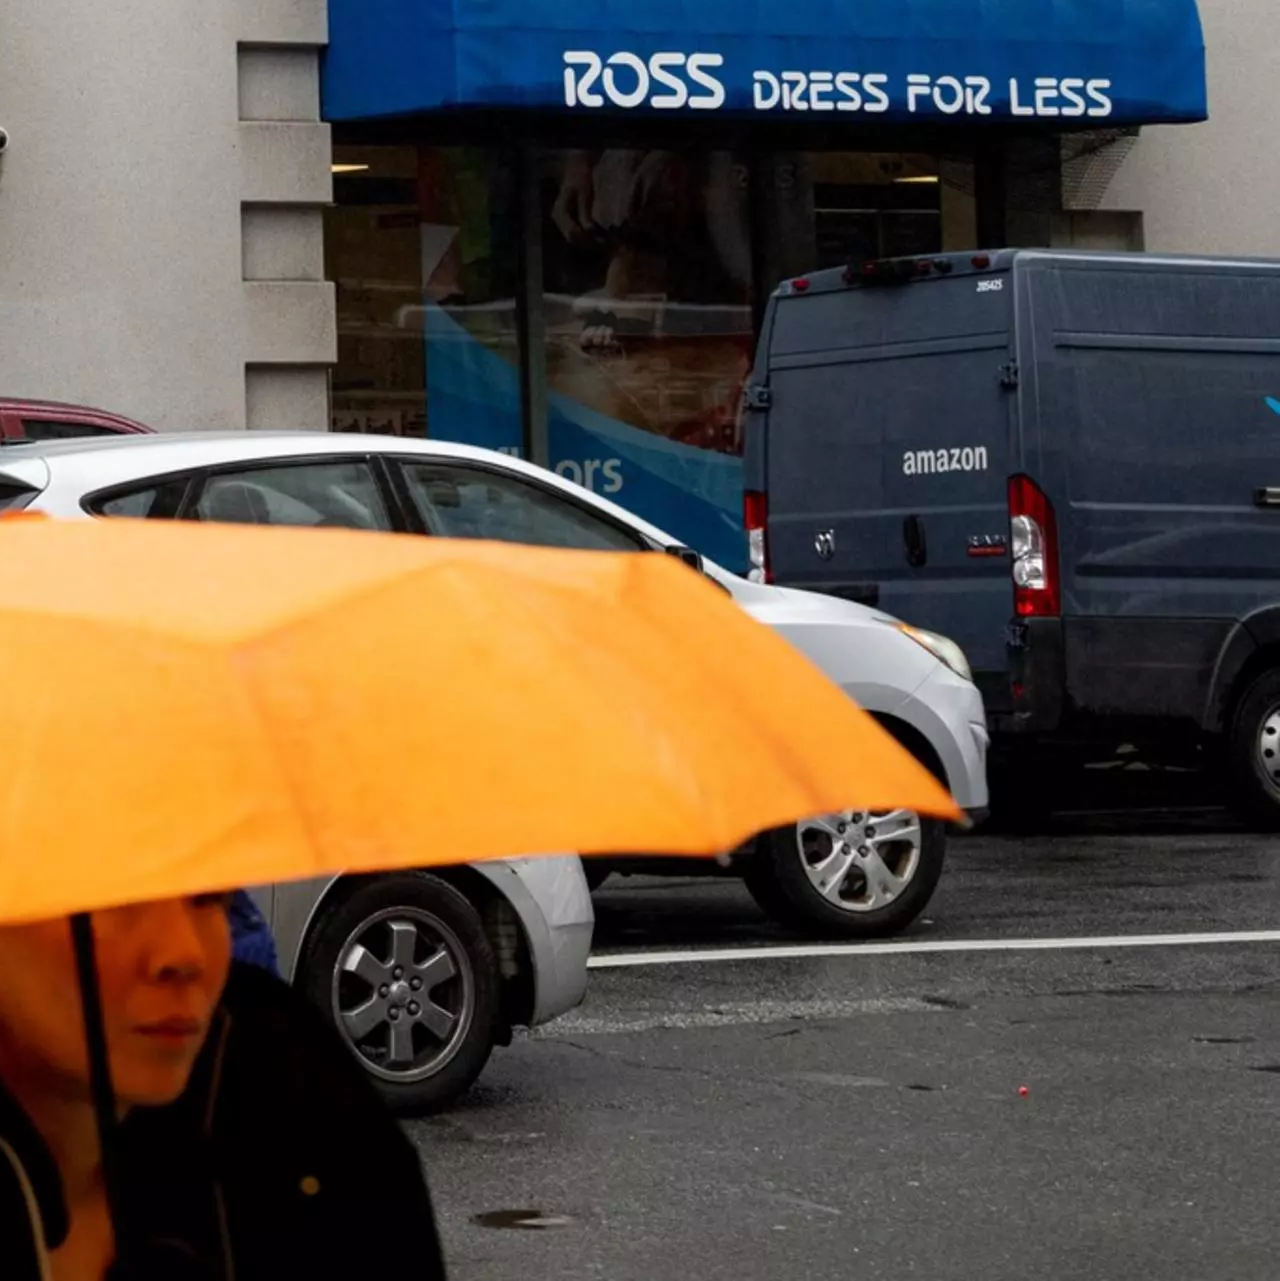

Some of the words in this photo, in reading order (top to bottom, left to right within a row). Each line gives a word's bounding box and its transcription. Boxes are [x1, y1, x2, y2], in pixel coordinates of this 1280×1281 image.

[563, 51, 726, 109] ROSS
[753, 70, 889, 112] DRESS
[907, 74, 992, 114] FOR
[1009, 77, 1112, 117] LESS
[902, 445, 988, 475] amazon
